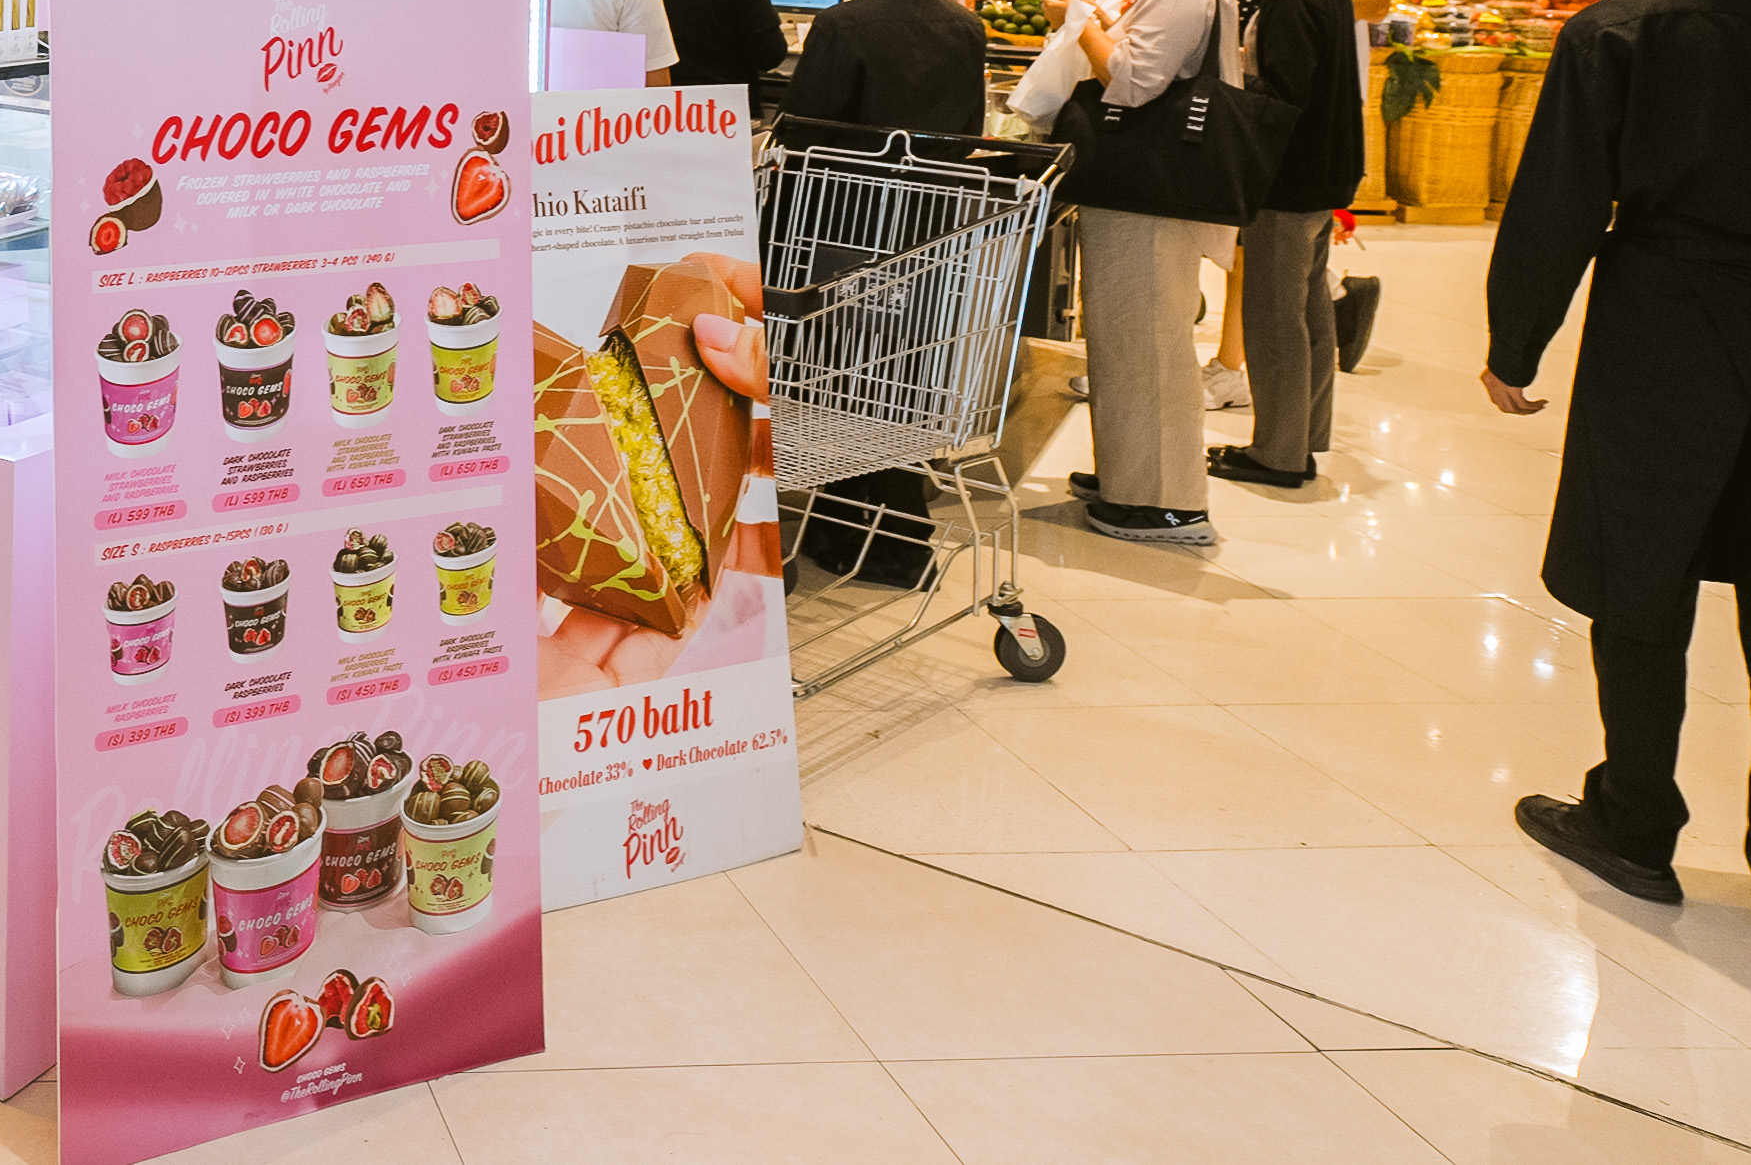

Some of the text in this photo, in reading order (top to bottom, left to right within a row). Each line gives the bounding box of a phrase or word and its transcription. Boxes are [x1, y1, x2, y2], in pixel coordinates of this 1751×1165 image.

[269, 1, 328, 36] Rolling
[261, 27, 343, 91] Pinn
[152, 103, 459, 165] CHOCO GEMS
[531, 91, 737, 165] ai Chocolate
[234, 169, 321, 187] STRAWBERRIES
[325, 168, 352, 182] AND
[355, 163, 429, 181] RASPBERRIES
[196, 179, 411, 205] COVERED IN WHITE CHOCOLATE AND
[532, 186, 647, 217] hio Kataifi
[226, 196, 384, 219] MILK OR DARK CHOCOLATE
[555, 227, 573, 237] every
[593, 224, 621, 235] Creamy
[624, 221, 655, 232] pistachio
[657, 218, 688, 229] chocolate
[717, 215, 744, 225] crunchy
[660, 234, 676, 242] treat
[678, 232, 705, 242] straight
[706, 230, 722, 238] from
[724, 228, 744, 237] Dubai
[98, 273, 123, 287] SIZE
[128, 273, 134, 284] L
[146, 269, 208, 283] RASPBERRIES
[251, 260, 317, 274] STRAWBERRIES
[321, 257, 337, 268] 3-4
[341, 256, 358, 266] PCS
[226, 382, 283, 396] CHOCO GEMS
[111, 402, 143, 413] CHOCO
[223, 449, 292, 466] DARK CHOCOLATE
[227, 460, 287, 475] STRAWBERRIES
[456, 459, 499, 474] 650 THB
[241, 469, 294, 483] RASPBERRIES
[350, 474, 393, 489] 650 THB
[243, 488, 288, 505] 599 THB
[127, 505, 175, 522] 599 THB
[101, 544, 129, 561] SIZE
[148, 536, 211, 553] RASPBERRIES
[456, 662, 499, 678] 450 THB
[224, 672, 292, 692] DARK CHOCOLATE
[232, 684, 285, 699] RASPBERRIES
[355, 679, 400, 696] 450 THB
[244, 701, 290, 719] 399 THB
[574, 689, 713, 753] 570 baht
[128, 723, 176, 743] 399 THB
[539, 728, 788, 796] Chocolate 33% Dark Chocolate 62.5%
[628, 799, 671, 832] Rolling
[630, 799, 645, 812] The
[325, 844, 396, 868] CHOCO GEMS
[623, 817, 683, 879] Pinn
[415, 852, 482, 873] CHOCO GEMS
[125, 898, 199, 928] CHOCO GEMS
[238, 898, 314, 933] CHOCO GEMS
[296, 1062, 346, 1084] CHOCO GEMS
[281, 1073, 363, 1103] @TheRollingPinn
